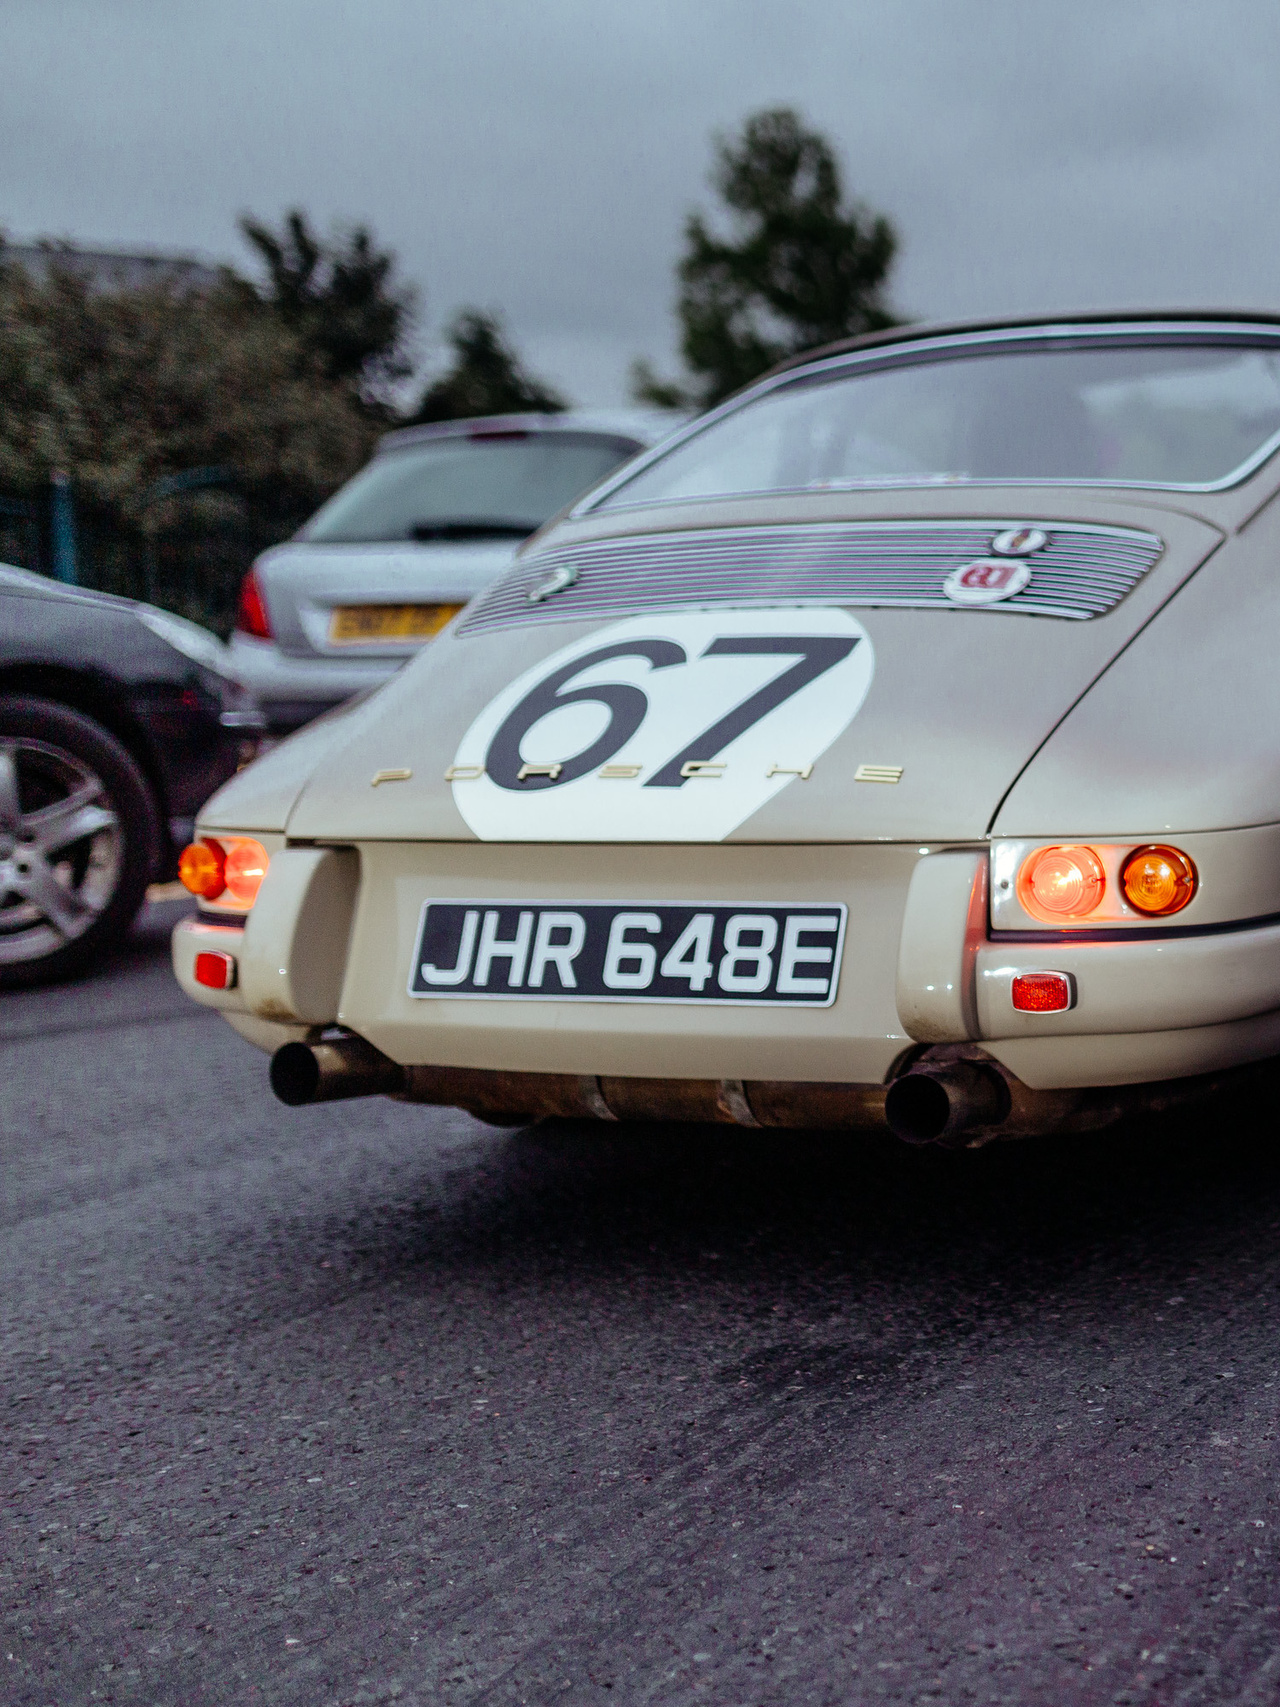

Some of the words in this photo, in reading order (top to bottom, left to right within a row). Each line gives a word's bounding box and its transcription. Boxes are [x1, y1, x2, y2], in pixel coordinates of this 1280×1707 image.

[485, 636, 862, 791] 67
[371, 761, 904, 787] PORSCHE
[420, 909, 587, 989] JHR
[602, 913, 839, 995] 648E
